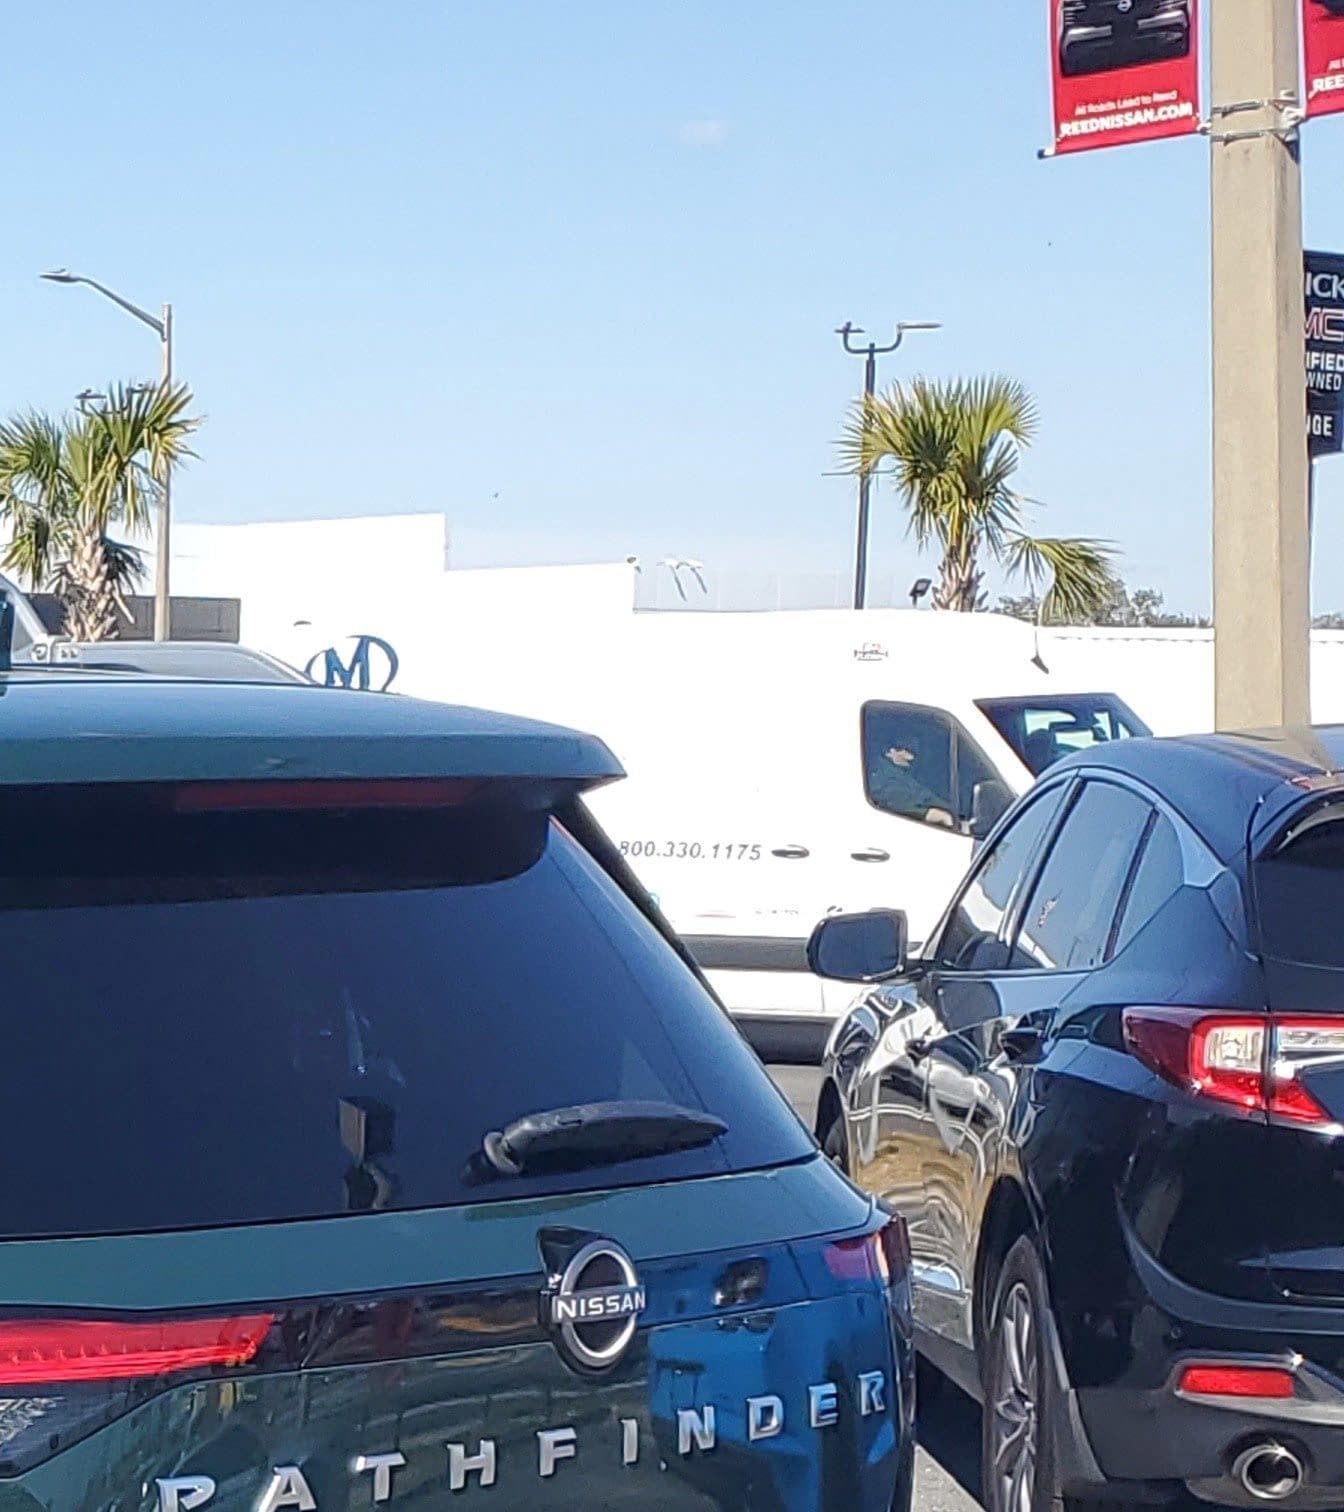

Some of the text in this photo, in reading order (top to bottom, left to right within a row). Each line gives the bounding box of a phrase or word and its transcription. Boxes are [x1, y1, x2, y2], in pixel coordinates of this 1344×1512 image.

[1059, 101, 1194, 137] REEDNISSAN.COM
[1305, 272, 1344, 299] ICK
[556, 1289, 646, 1319] NISSAN
